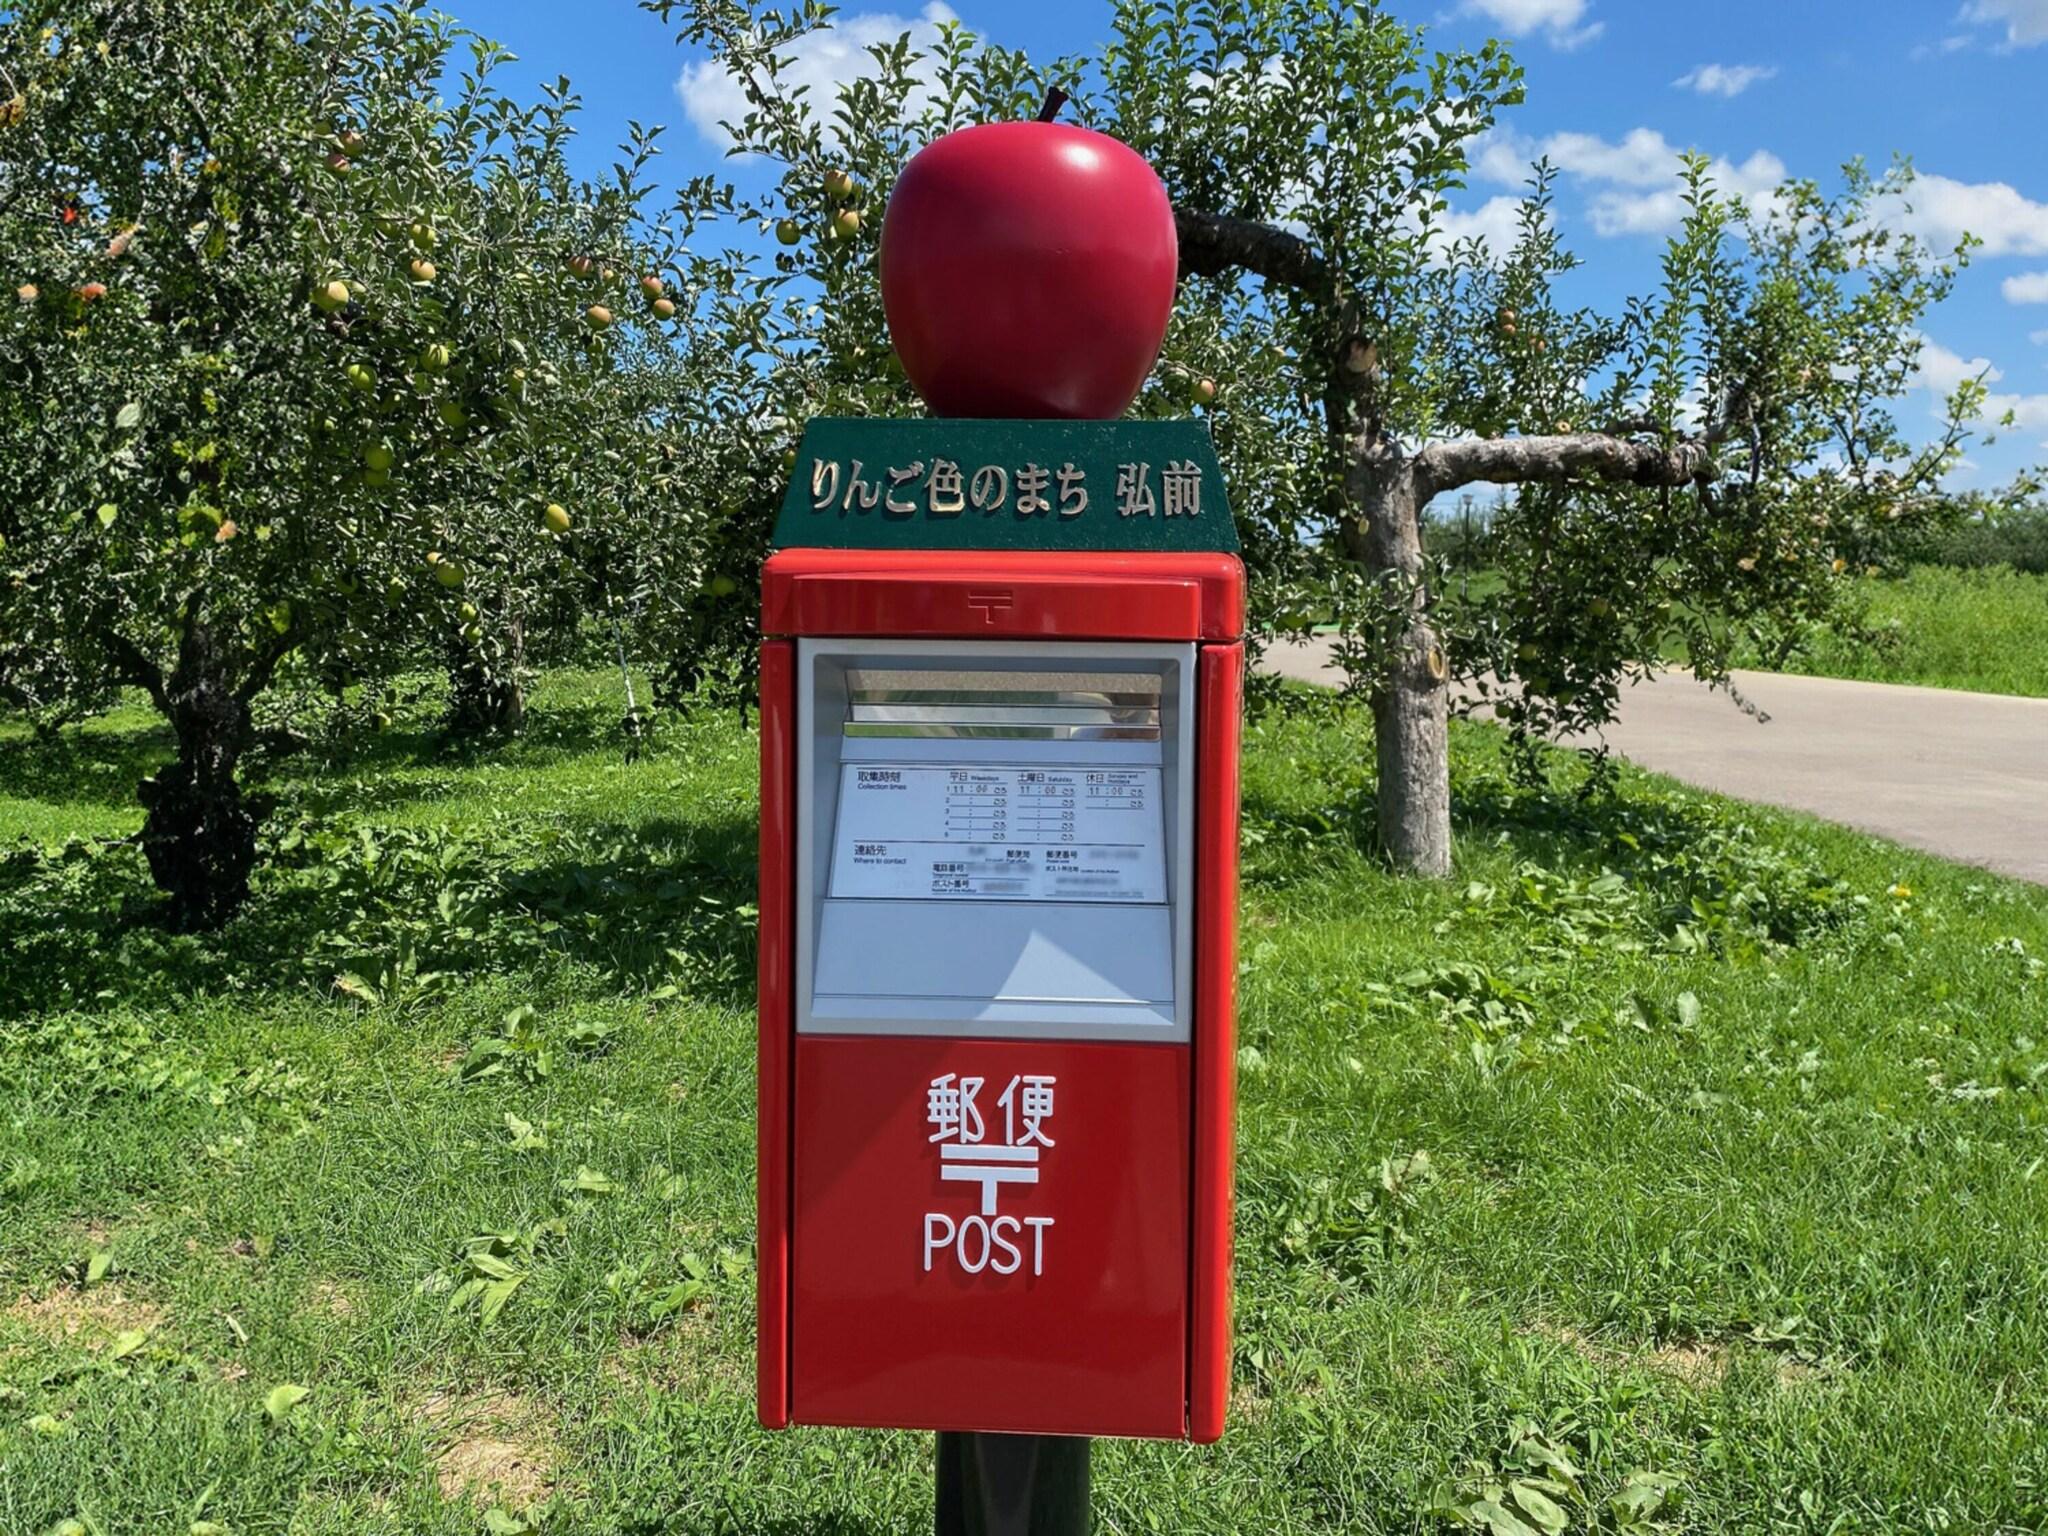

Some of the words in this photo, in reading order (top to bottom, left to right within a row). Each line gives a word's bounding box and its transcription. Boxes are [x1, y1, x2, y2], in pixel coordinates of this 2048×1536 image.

[812, 458, 1089, 515] りんご色のまち
[1115, 460, 1203, 517] 弘前
[854, 844, 887, 856] 連絡先
[927, 1072, 1056, 1147] 郵便
[924, 1213, 1055, 1276] POST
